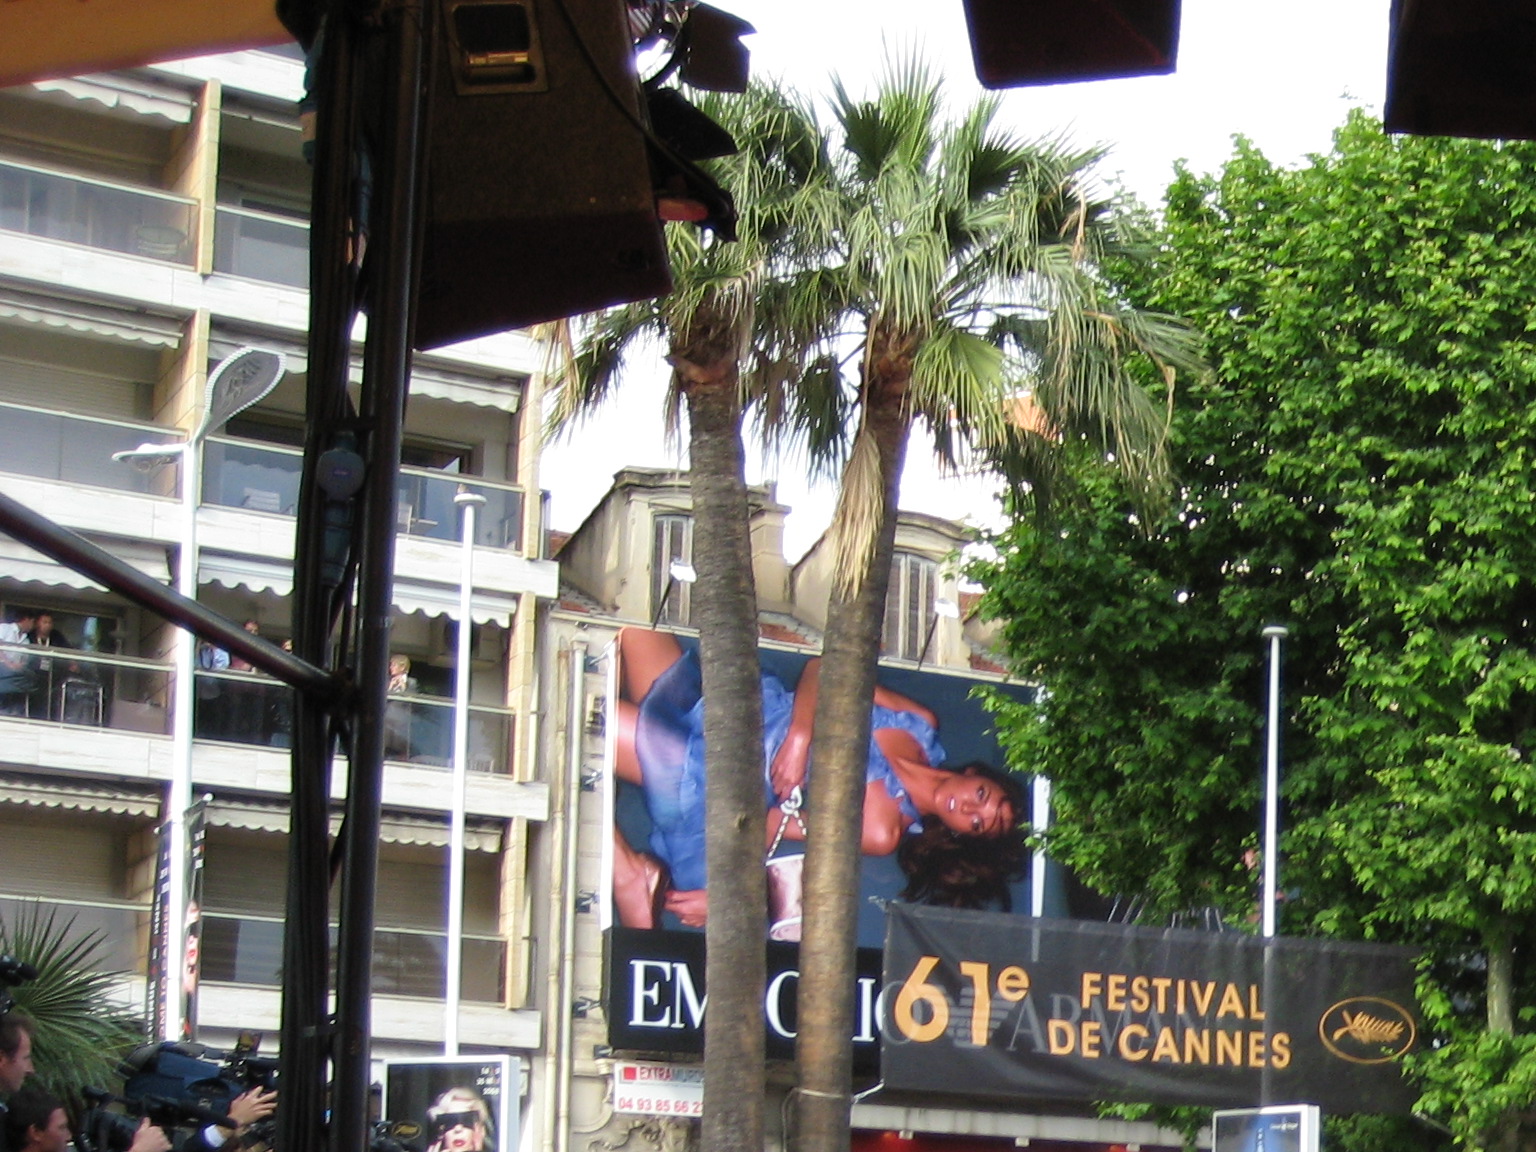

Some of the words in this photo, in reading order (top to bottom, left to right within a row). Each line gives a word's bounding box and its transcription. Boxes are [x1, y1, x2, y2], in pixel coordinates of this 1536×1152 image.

[895, 955, 1031, 1046] 61e
[1081, 971, 1266, 1021] FESTIVAL
[1048, 1018, 1101, 1059] DE
[1118, 1023, 1292, 1070] CANNES
[618, 1097, 633, 1110] 04
[636, 1098, 652, 1111] 93
